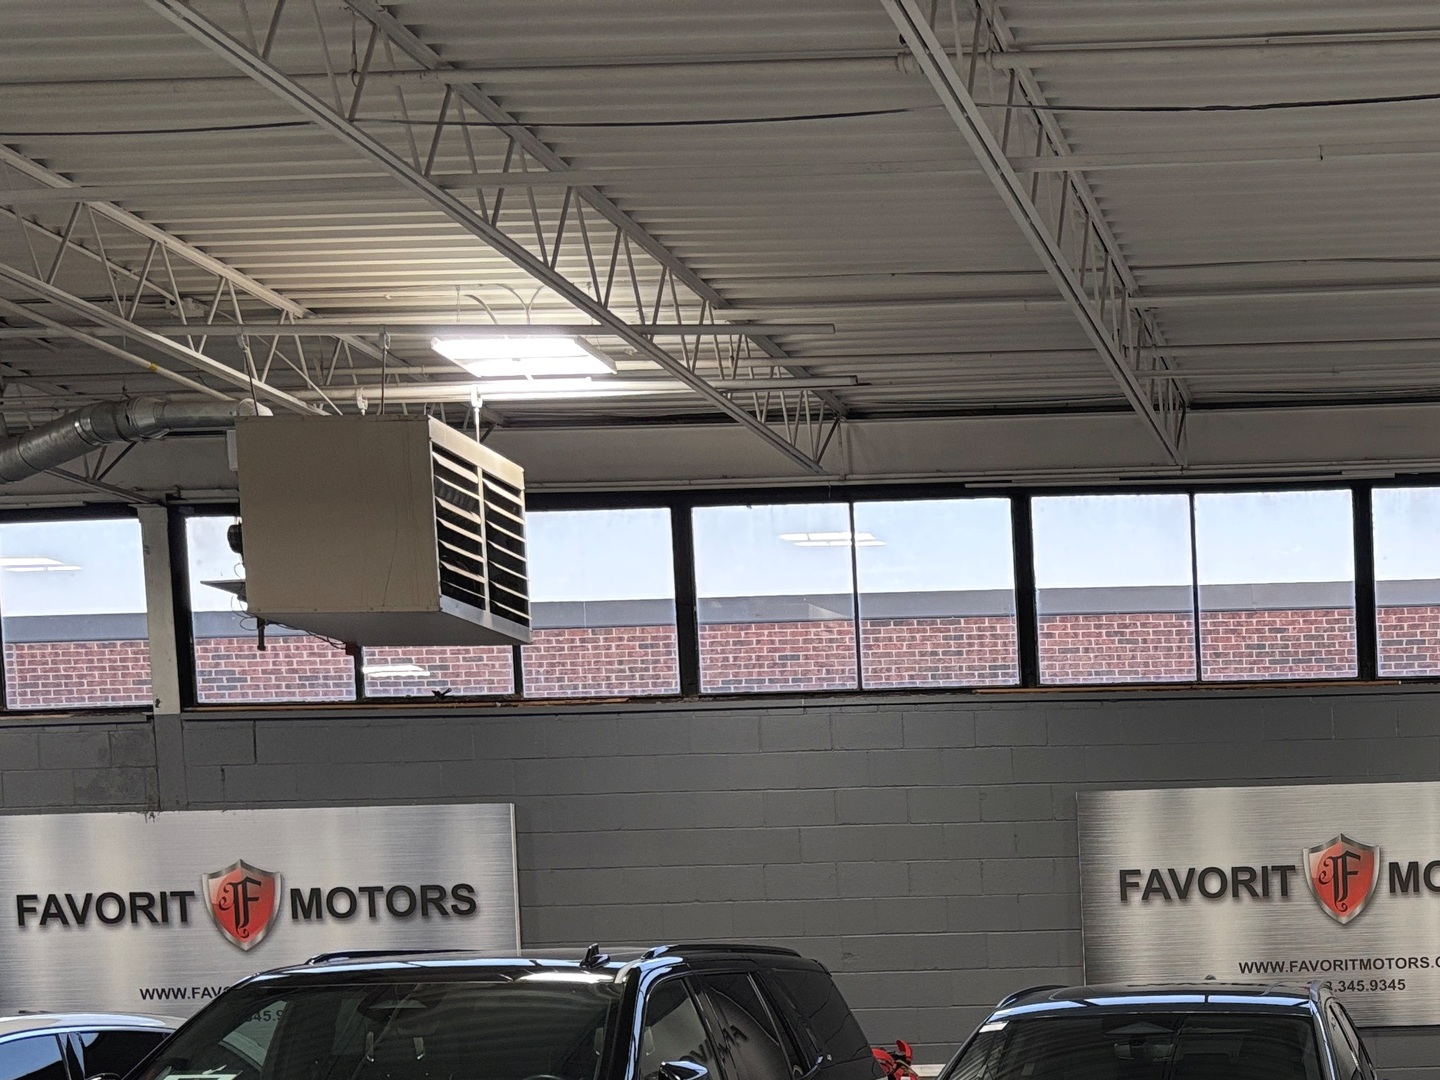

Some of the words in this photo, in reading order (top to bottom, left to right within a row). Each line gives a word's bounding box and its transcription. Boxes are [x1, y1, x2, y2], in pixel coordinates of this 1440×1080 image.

[1118, 863, 1296, 901] FAVORIT
[16, 889, 195, 927] FAVORIT
[290, 883, 478, 921] MOTORS
